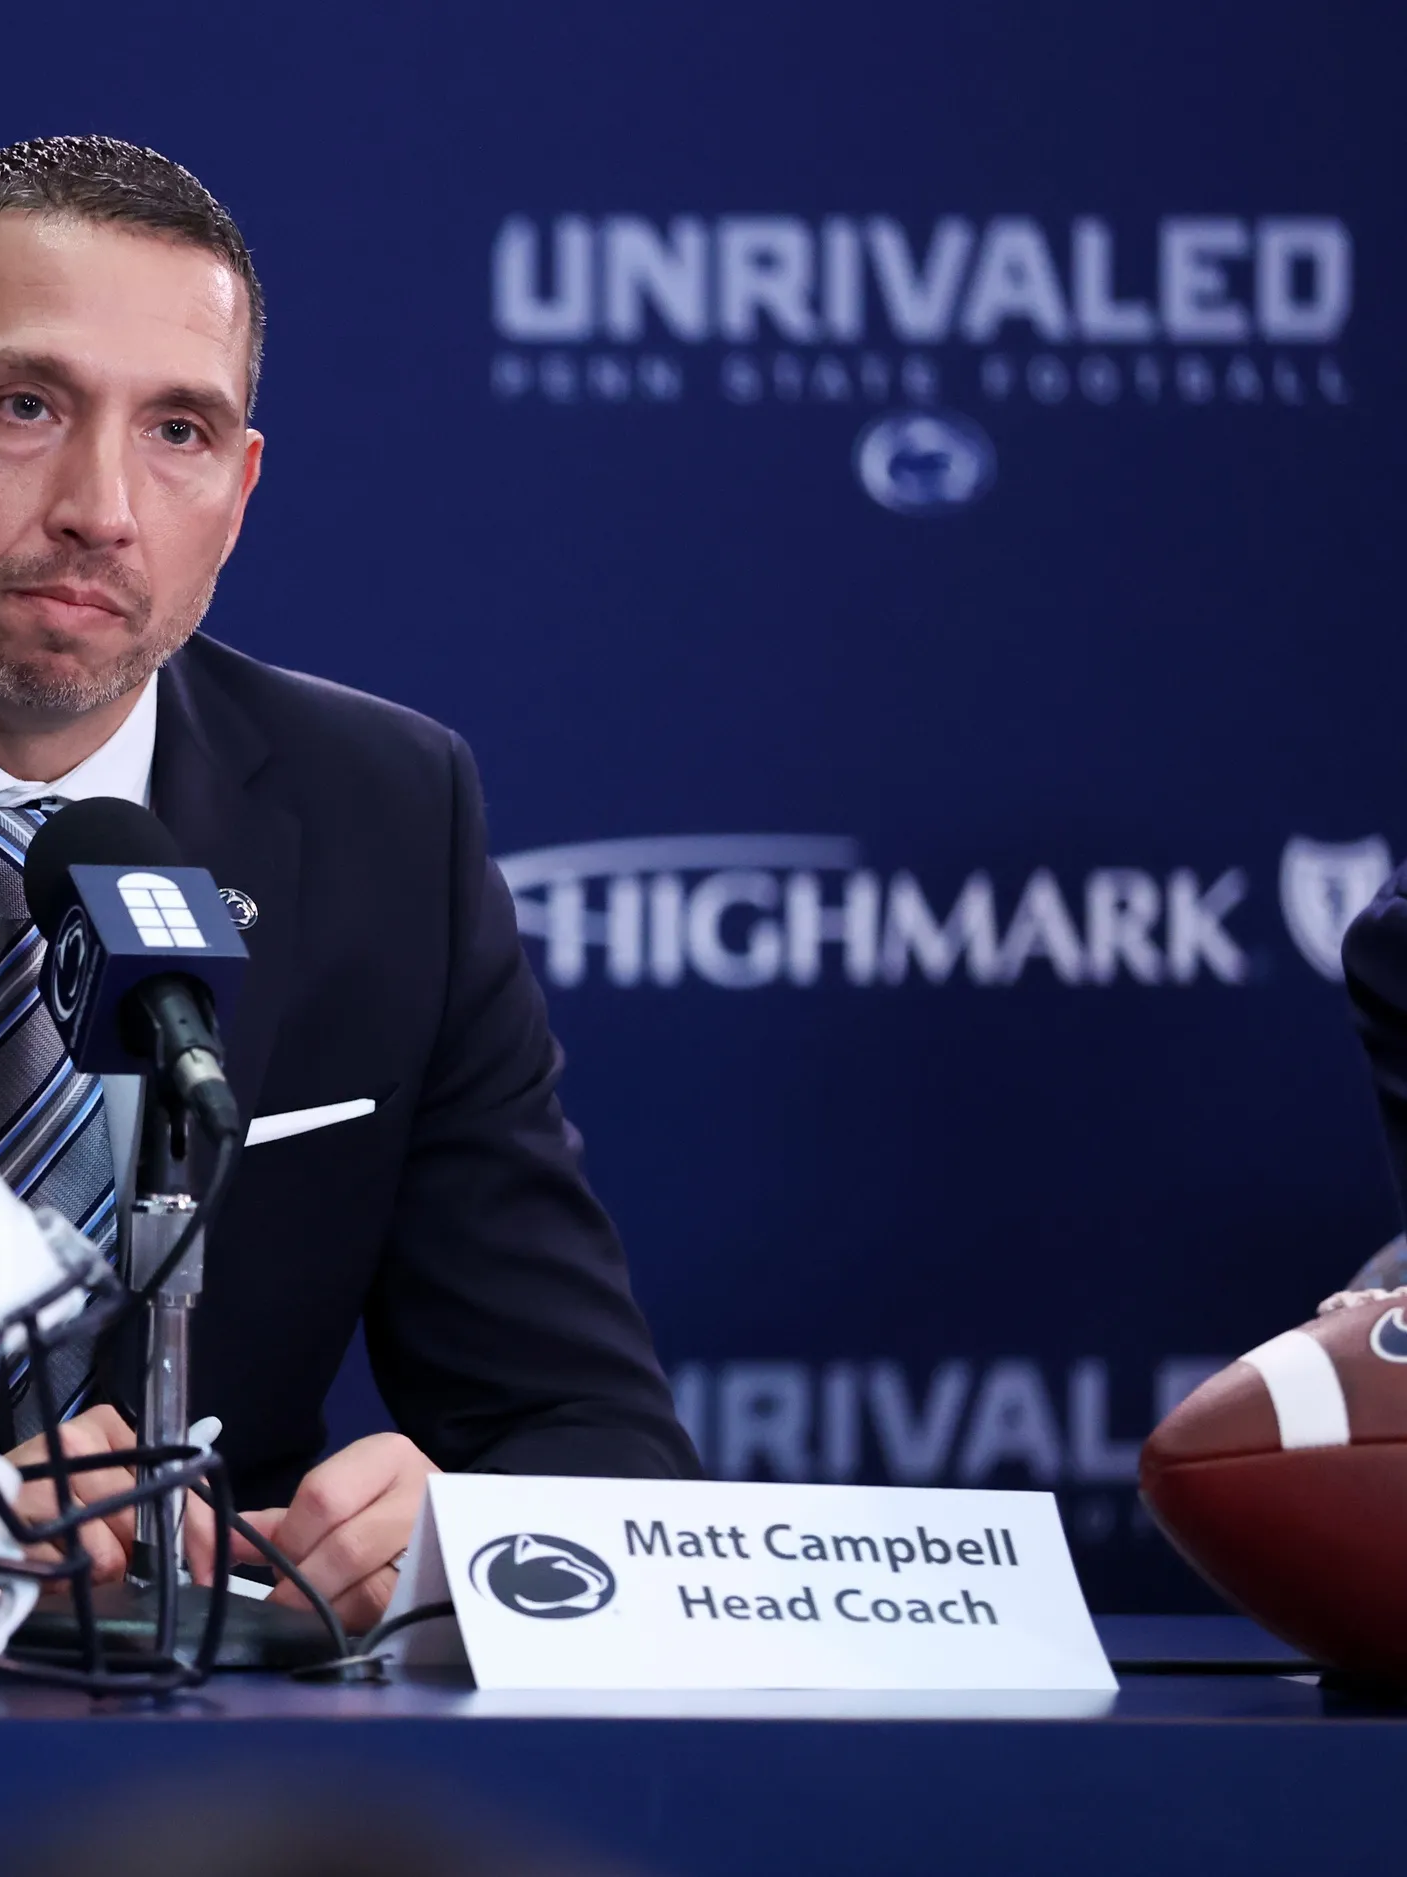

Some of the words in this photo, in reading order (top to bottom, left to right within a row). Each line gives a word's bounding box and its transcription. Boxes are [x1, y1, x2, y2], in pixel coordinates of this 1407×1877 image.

[492, 213, 1352, 344] UNRIVALED
[547, 866, 1248, 988] HIGHMARK
[623, 1519, 751, 1560] Matt
[764, 1524, 1019, 1573] Campbell
[677, 1585, 821, 1622] Head
[834, 1588, 999, 1626] Coach
